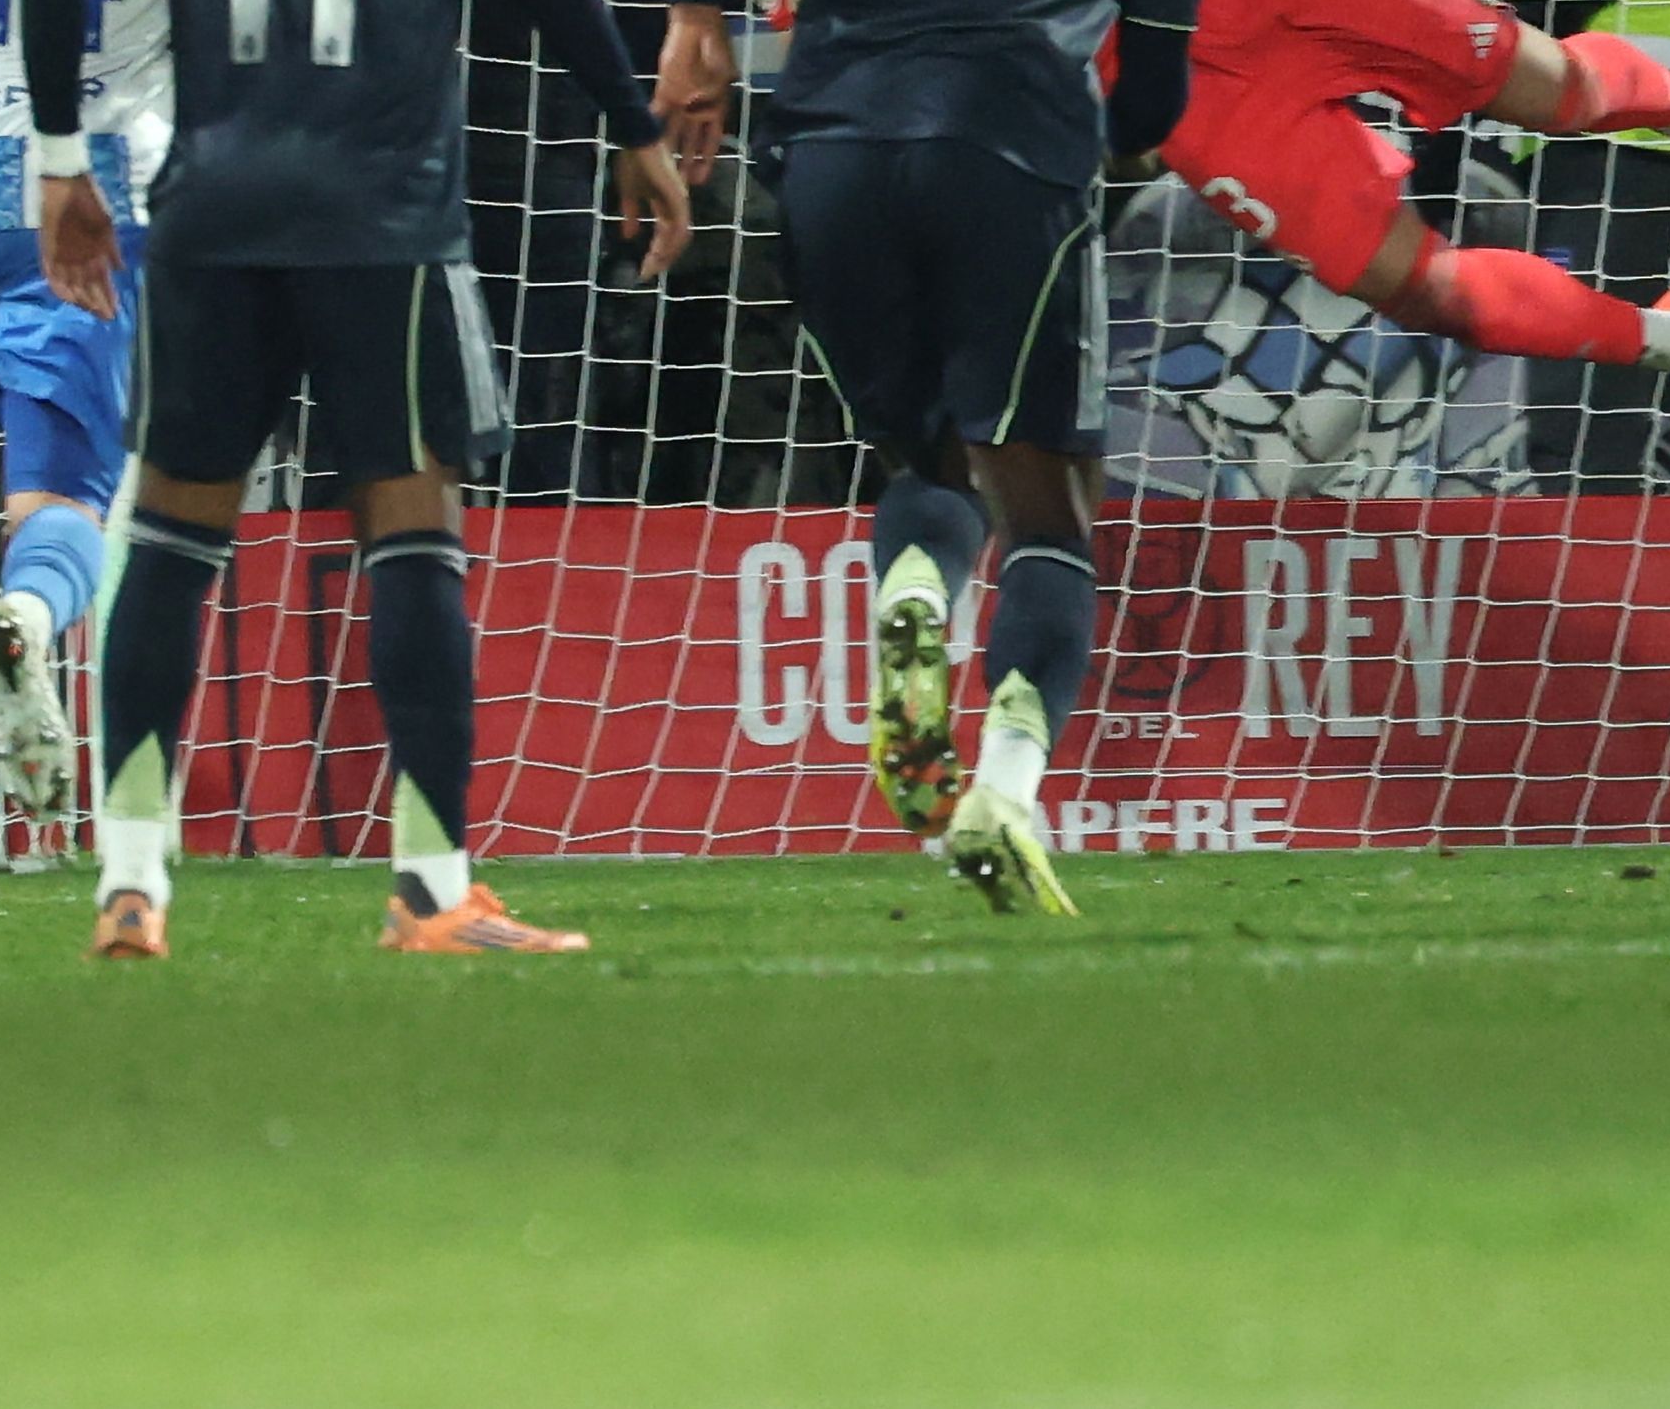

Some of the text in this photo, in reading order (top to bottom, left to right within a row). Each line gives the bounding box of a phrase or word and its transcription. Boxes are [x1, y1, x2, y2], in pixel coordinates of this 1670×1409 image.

[1103, 714, 1199, 741] DEL
[1243, 536, 1466, 740] REY
[1032, 798, 1290, 852] APFRE
